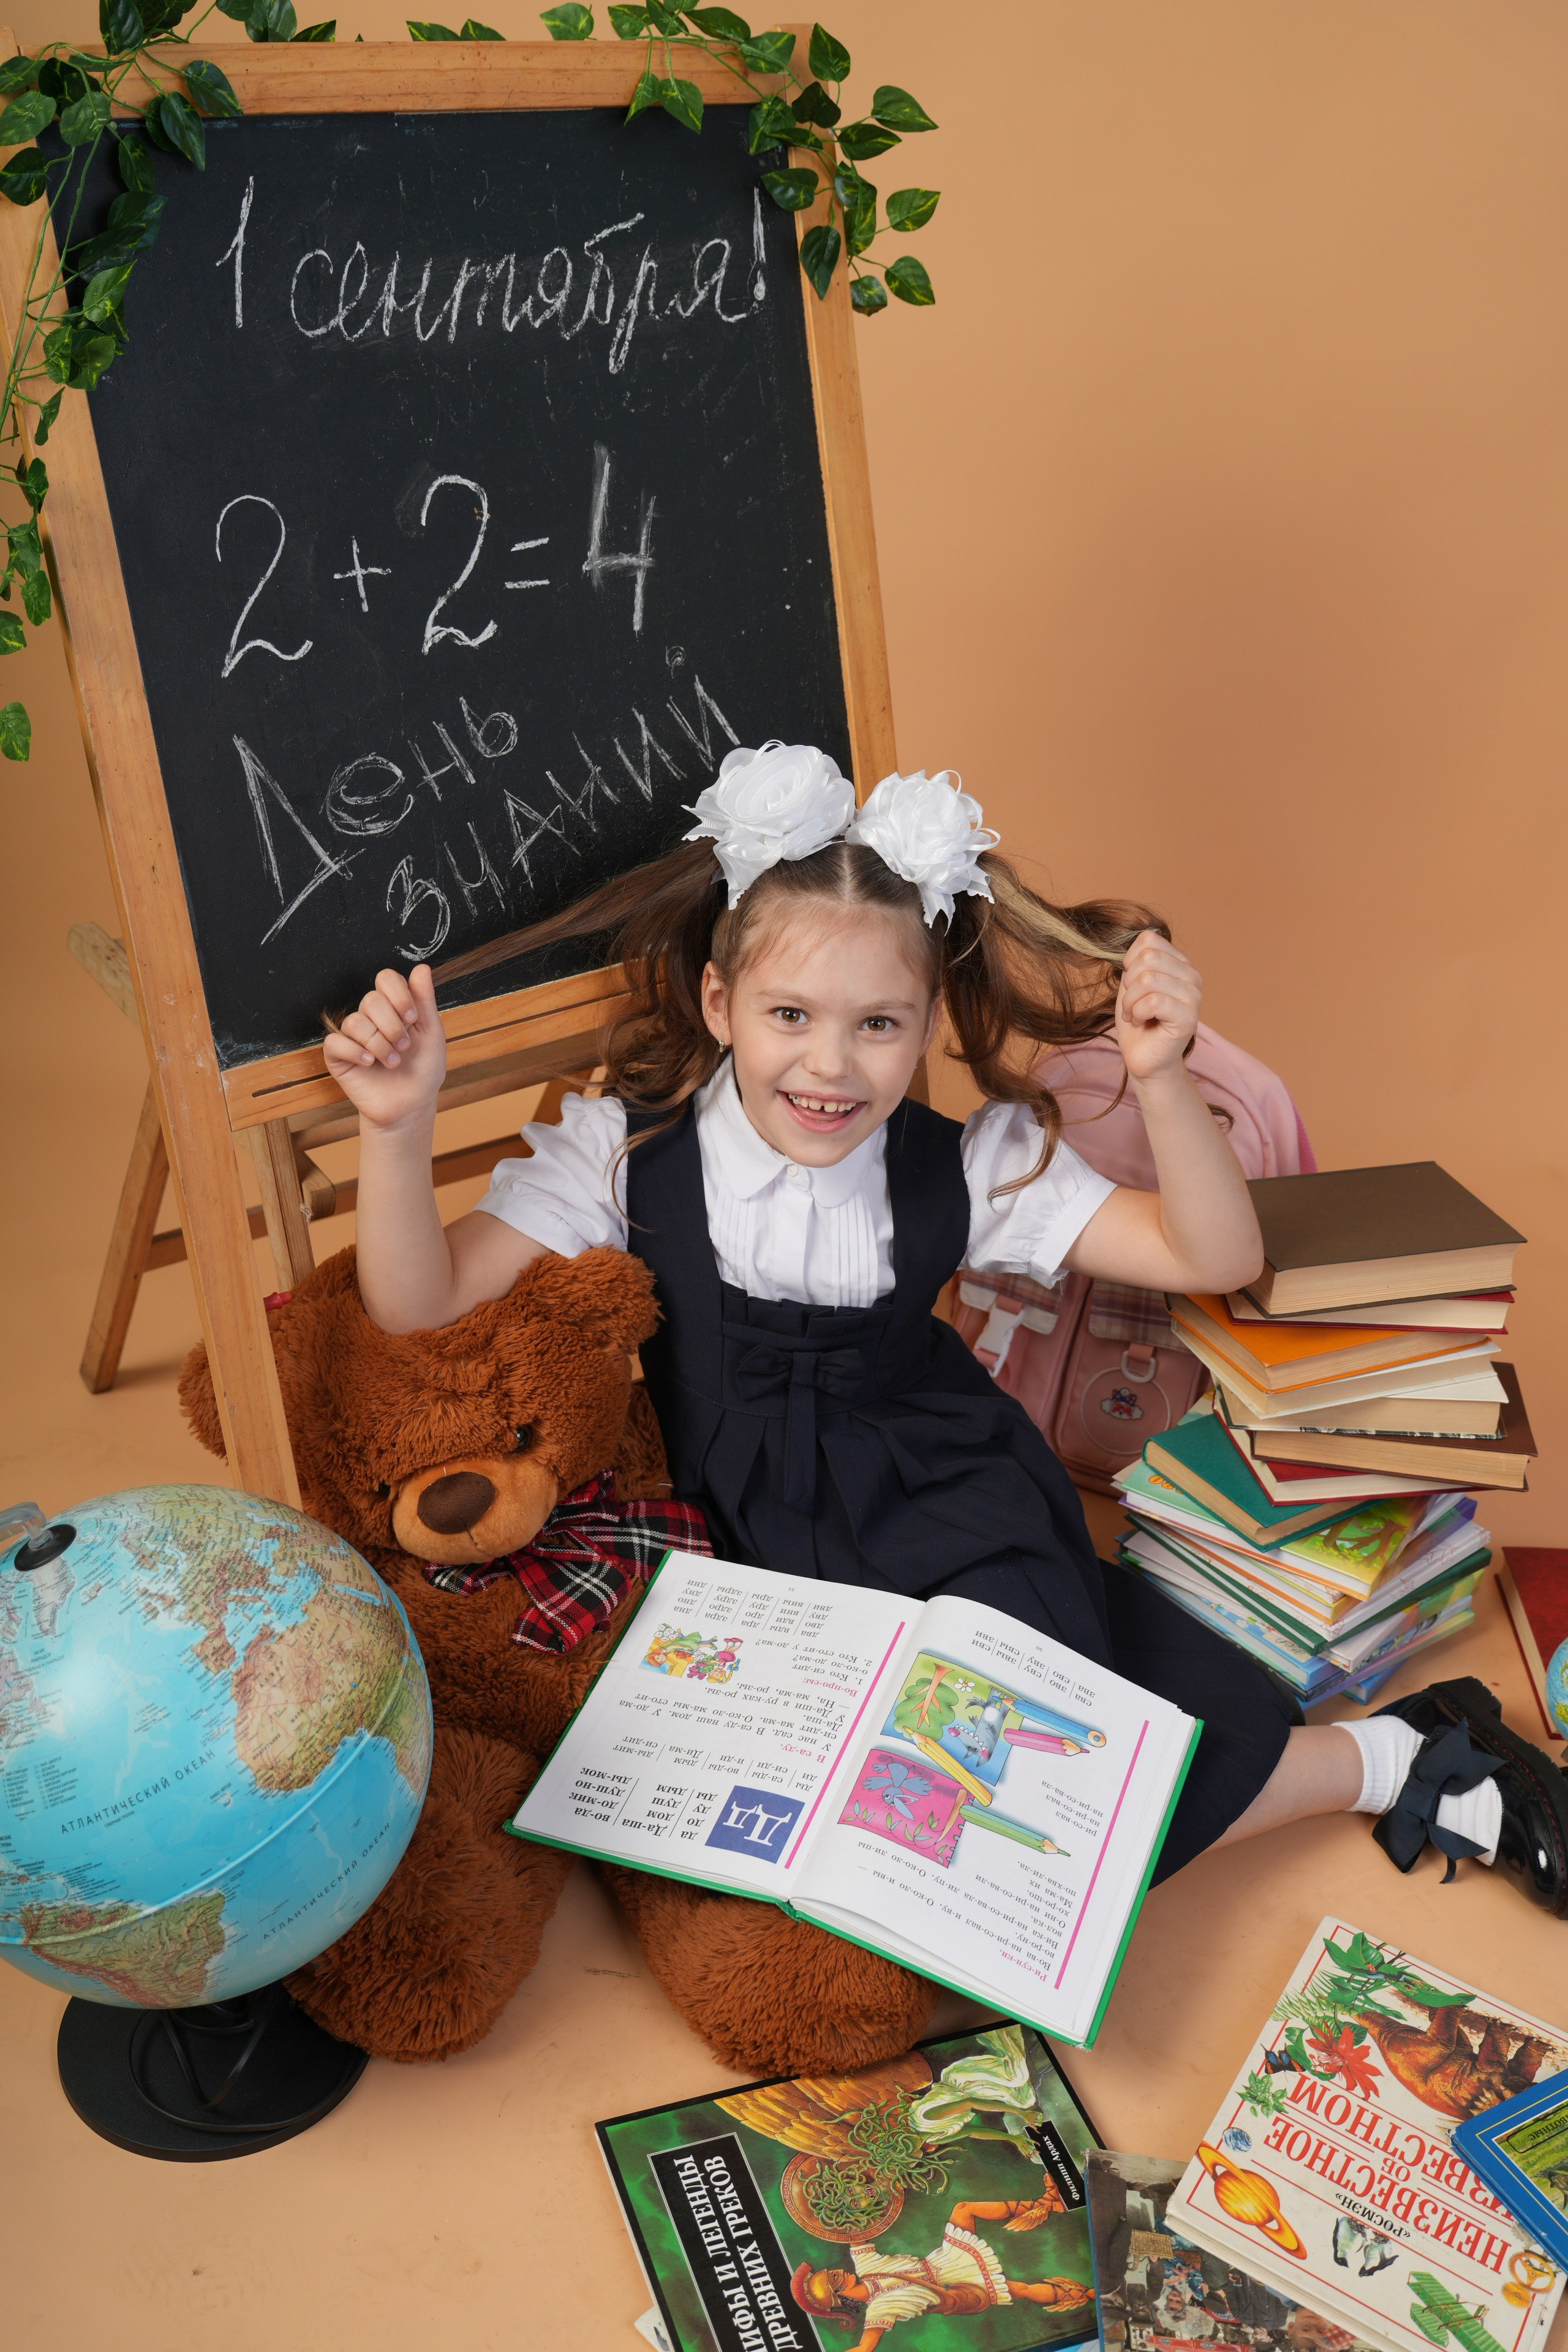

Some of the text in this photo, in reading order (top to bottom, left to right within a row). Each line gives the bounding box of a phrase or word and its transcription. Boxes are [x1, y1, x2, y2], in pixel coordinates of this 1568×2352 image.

[216, 175, 766, 374] 1 сентября!
[216, 494, 313, 678] 2
[421, 474, 498, 655] 2
[582, 450, 655, 635] 4
[680, 1586, 829, 1621] дву вни дру здру дну
[685, 1579, 834, 1612] дви вны дры здры дни
[303, 1617, 319, 1639] ЛИВИЯ
[673, 1605, 820, 1638] два вды дра здра дна
[677, 1596, 825, 1629] дво вди дро здро дно
[29, 1652, 51, 1663] ЛАБРАДОР
[754, 1638, 790, 1648] до-ма?
[802, 1646, 834, 1656] сто-ит
[838, 1652, 859, 1664] Кто
[259, 1660, 285, 1688] АЛЖИР
[791, 1654, 869, 1675] о-ко-ло до-ма?
[791, 1660, 863, 1685] 1. Кто си-дит
[864, 1658, 873, 1667] 2.
[970, 1638, 1092, 1707] сва зво сву звы сви
[973, 1629, 1095, 1698] зва сво зву свы зви
[704, 1686, 739, 1698] ро-зы.
[736, 1682, 836, 1709] На, ма-ма, ро-зы.
[741, 1693, 780, 1705] ру-ках
[802, 1677, 858, 1698] Во-про-сы:
[290, 1707, 305, 1723] МАЛИ
[618, 1699, 832, 1752] У нас сад. В са-ду наш дом. У до-ма
[633, 1692, 839, 1740] си-дит ма-ма. О-ко-ло ма-мы сто-ит
[793, 1702, 834, 1719] Да-ши
[802, 1714, 844, 1732] Да-ша.
[834, 1713, 845, 1723] У
[251, 1732, 282, 1760] МАВРИТАНИЯ
[621, 1735, 818, 1782] ди си-ди и-ди Ди-ма си-дит
[780, 1743, 827, 1764] В са-ду.
[579, 1766, 719, 1802] ды дым ды-мок
[611, 1744, 813, 1792] ды са-ды во-ды дым ды-мит
[62, 1748, 215, 1834] АТЛАНТИЧЕСКИЙ ОКЕАН
[574, 1779, 712, 1815] ду душ душ-но
[1041, 1779, 1104, 1818] на-ри-со-ва-ла
[567, 1791, 706, 1828] до дом до-мик
[573, 1806, 699, 1841] да Да-ша во-да
[1044, 1793, 1100, 1828] на-ри-со-вал
[1055, 1810, 1098, 1837] ри-со-вал
[263, 1822, 389, 1940] АТЛАНТИЧЕСКИЙ ОКЕАН
[1017, 1860, 1077, 1897] по-хва-ли-ла.
[1028, 1879, 1074, 1909] Ма-ма их
[857, 1841, 1059, 1951] Ви-ка на-ри-со-ва-ла ли-пу. О-ко-ло ли-пы
[974, 1873, 1066, 1929] О-ни на-ри-со-ва-ли
[1027, 1889, 1070, 1917] хо-ро-шо.
[872, 1869, 1052, 1972] Во-ва на-ри-со-вал и-ву. О-ко-ло и-вы
[1030, 1915, 1063, 1938] вол-ка.
[1014, 1931, 1055, 1959] во-ро-ну.
[999, 1948, 1047, 1982] Ри-сун-ки.
[1042, 2135, 1080, 2200] Филипп Ардах
[1380, 2157, 1411, 2182] ОБ
[673, 2154, 731, 2258] ЛЕГЕНДЫ
[1262, 2114, 1512, 2275] НЕИЗВЕСТНОЕ
[1334, 2192, 1411, 2238] «РОСМЭН»
[703, 2155, 803, 2352] ДРЕВНИХ ГРЕКОВ
[713, 2260, 739, 2283] И
